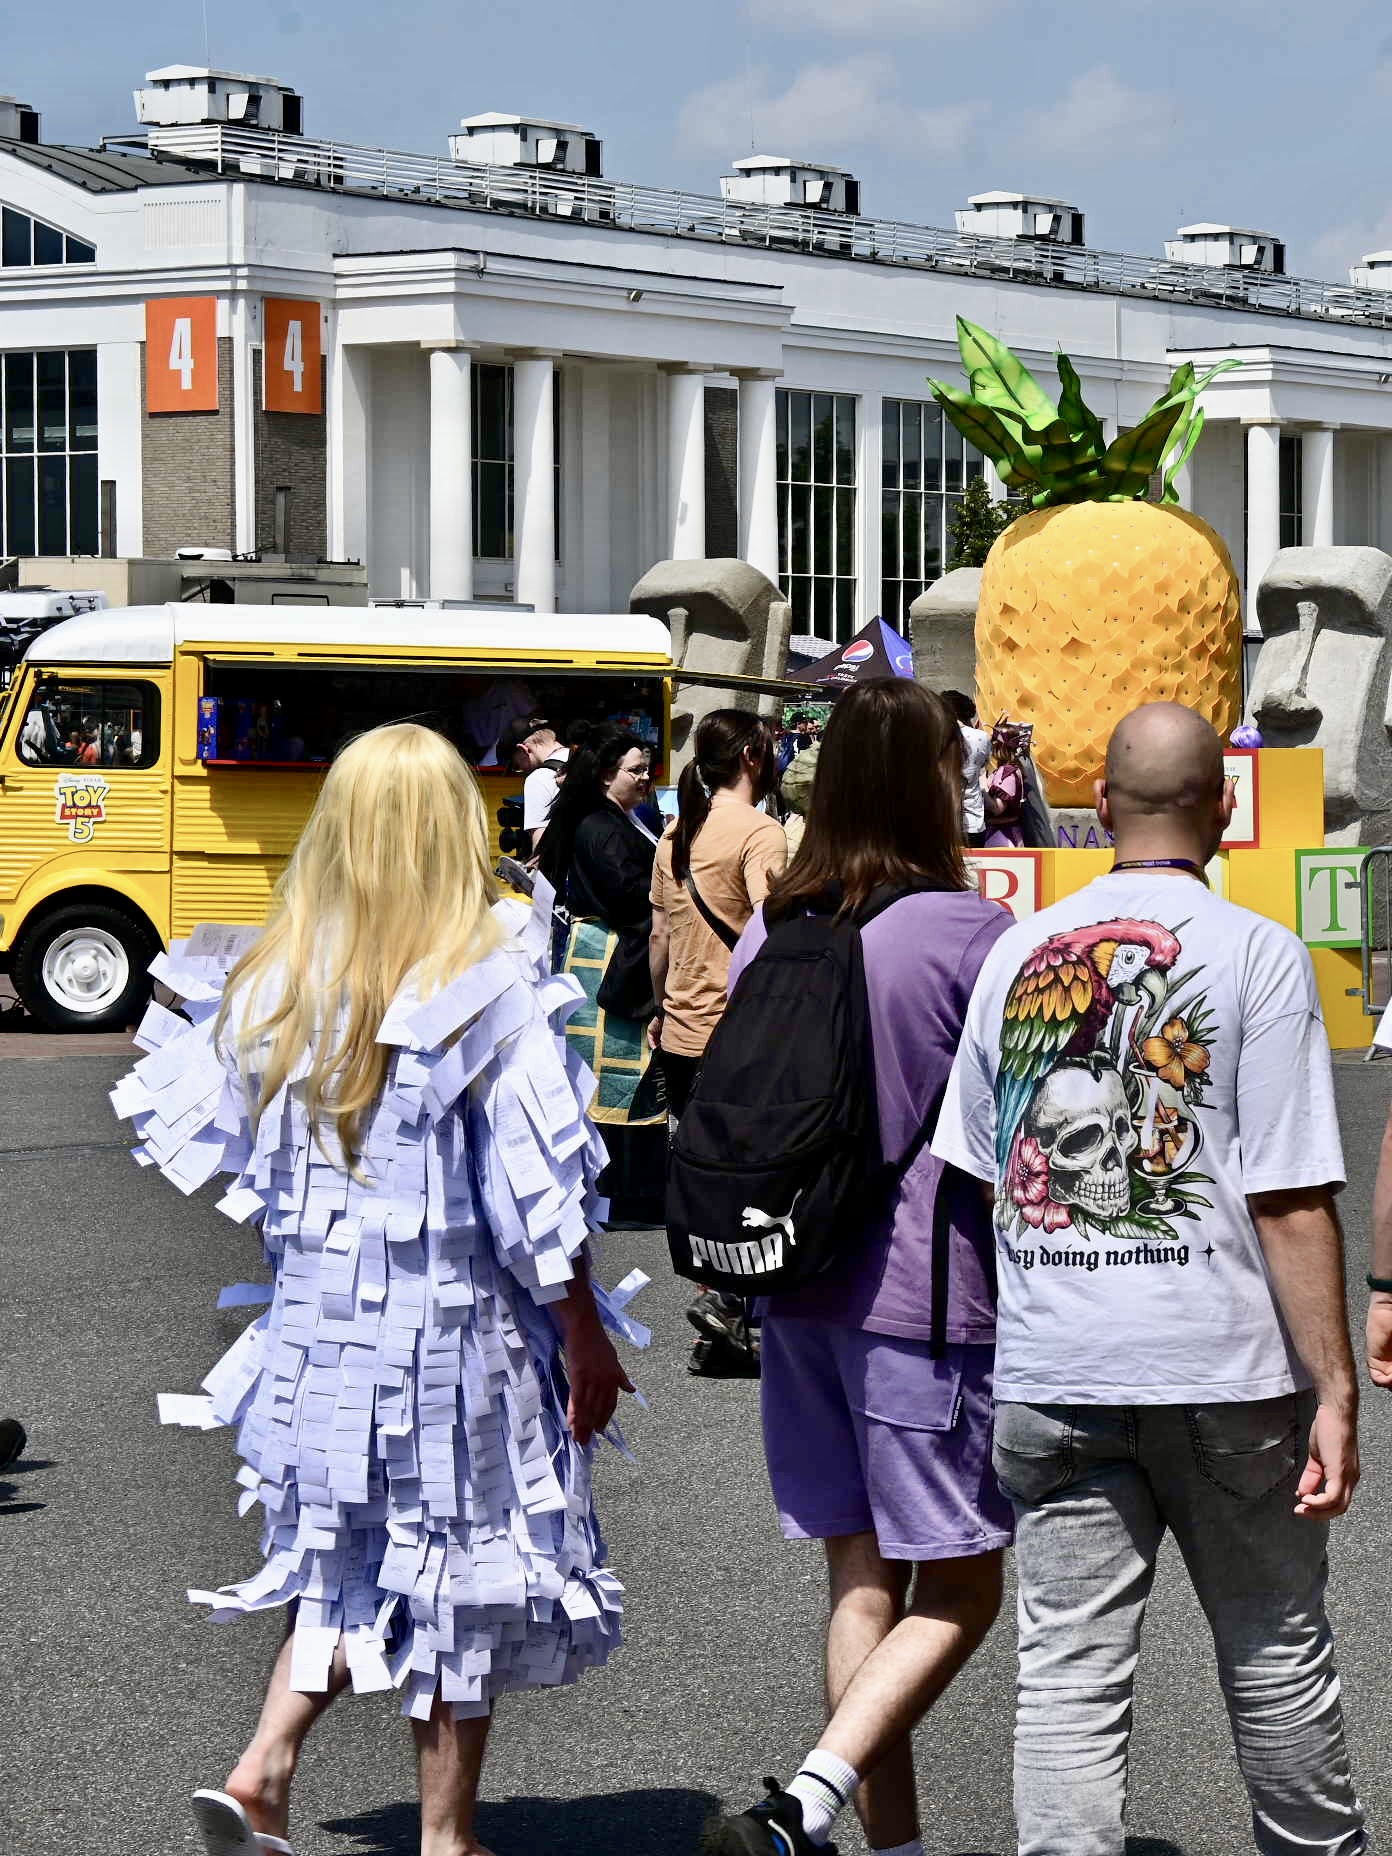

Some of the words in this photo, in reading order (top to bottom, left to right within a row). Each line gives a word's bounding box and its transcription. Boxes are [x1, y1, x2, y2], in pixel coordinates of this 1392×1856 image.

[169, 318, 195, 390] 4
[283, 320, 305, 392] 4
[59, 784, 107, 808] TOY
[64, 807, 99, 816] STORY
[73, 816, 91, 840] 5
[970, 868, 1019, 922] R
[1308, 866, 1358, 932] T
[688, 1232, 784, 1275] PUMA
[1039, 1243, 1100, 1272] doing
[1105, 1240, 1190, 1267] nothing
